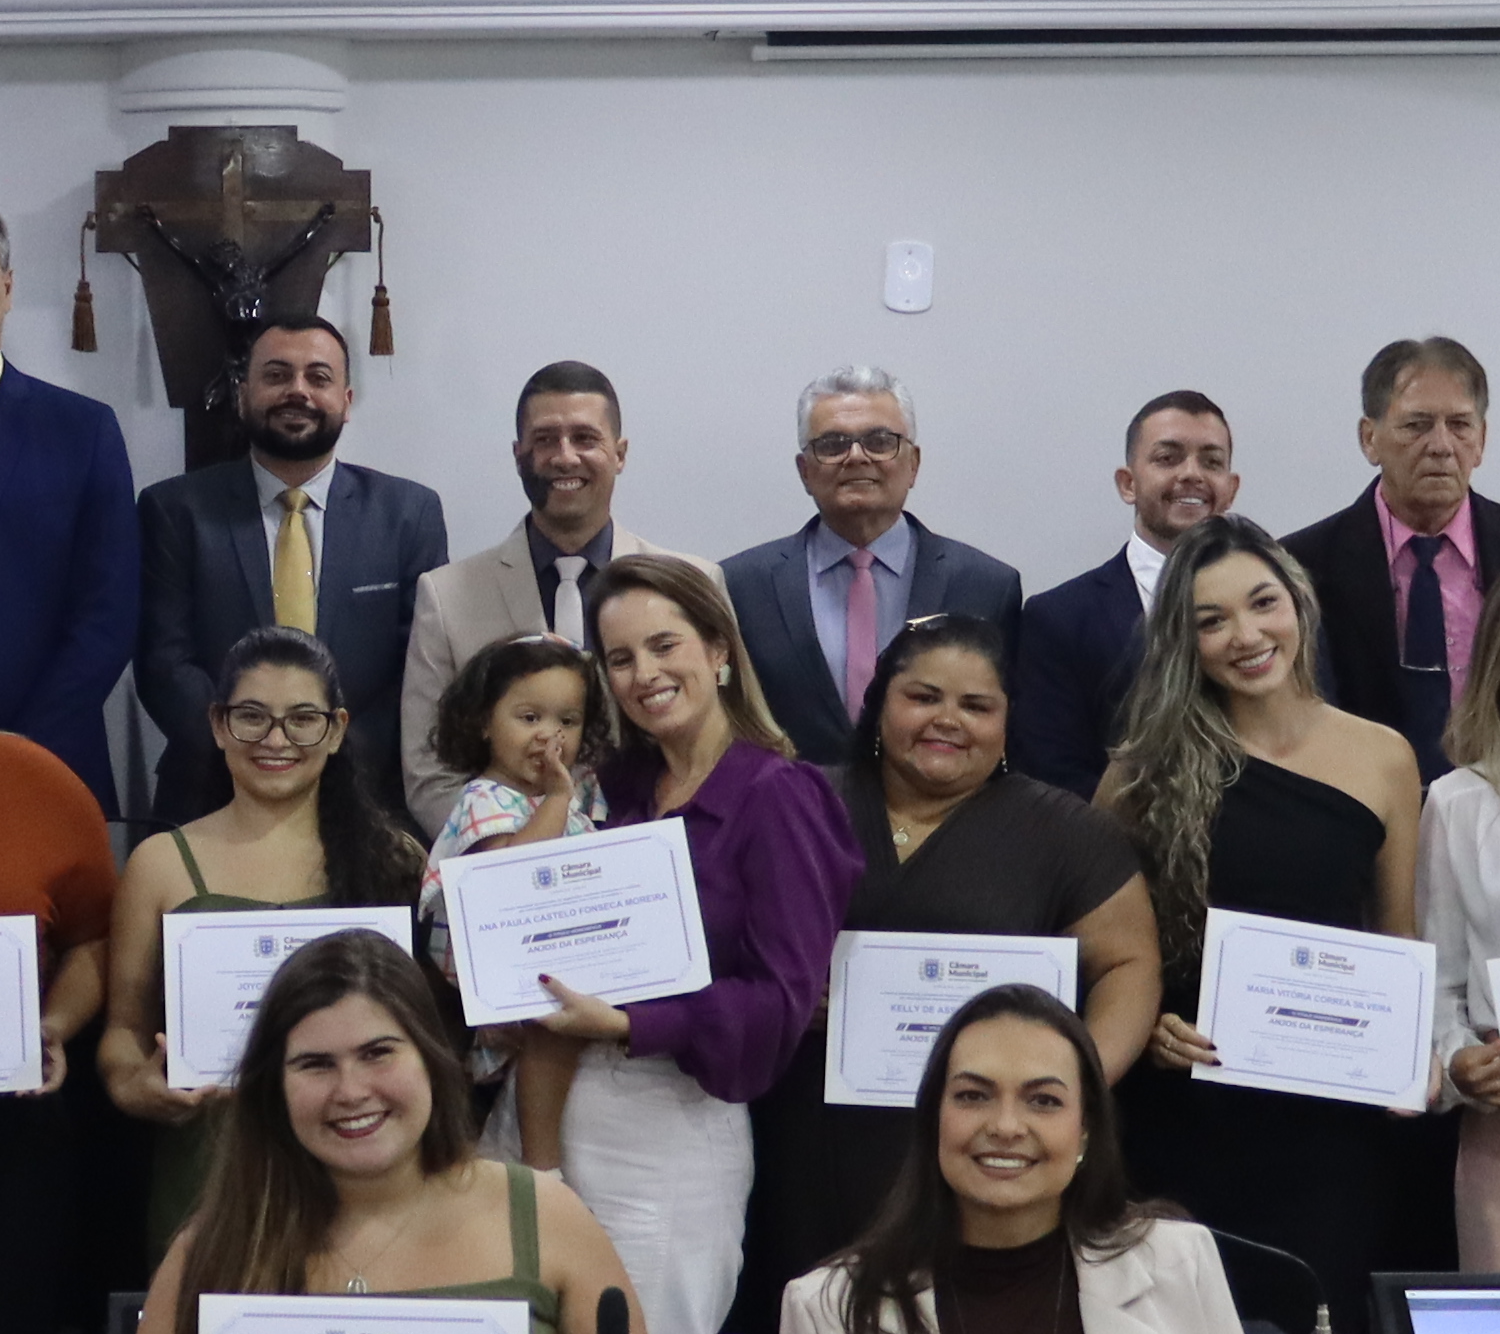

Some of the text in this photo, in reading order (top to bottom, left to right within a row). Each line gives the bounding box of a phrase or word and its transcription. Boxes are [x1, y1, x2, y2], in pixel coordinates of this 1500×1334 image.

[478, 921, 498, 933] ANA
[500, 916, 531, 929] PAULA
[579, 900, 622, 915] FONSECA
